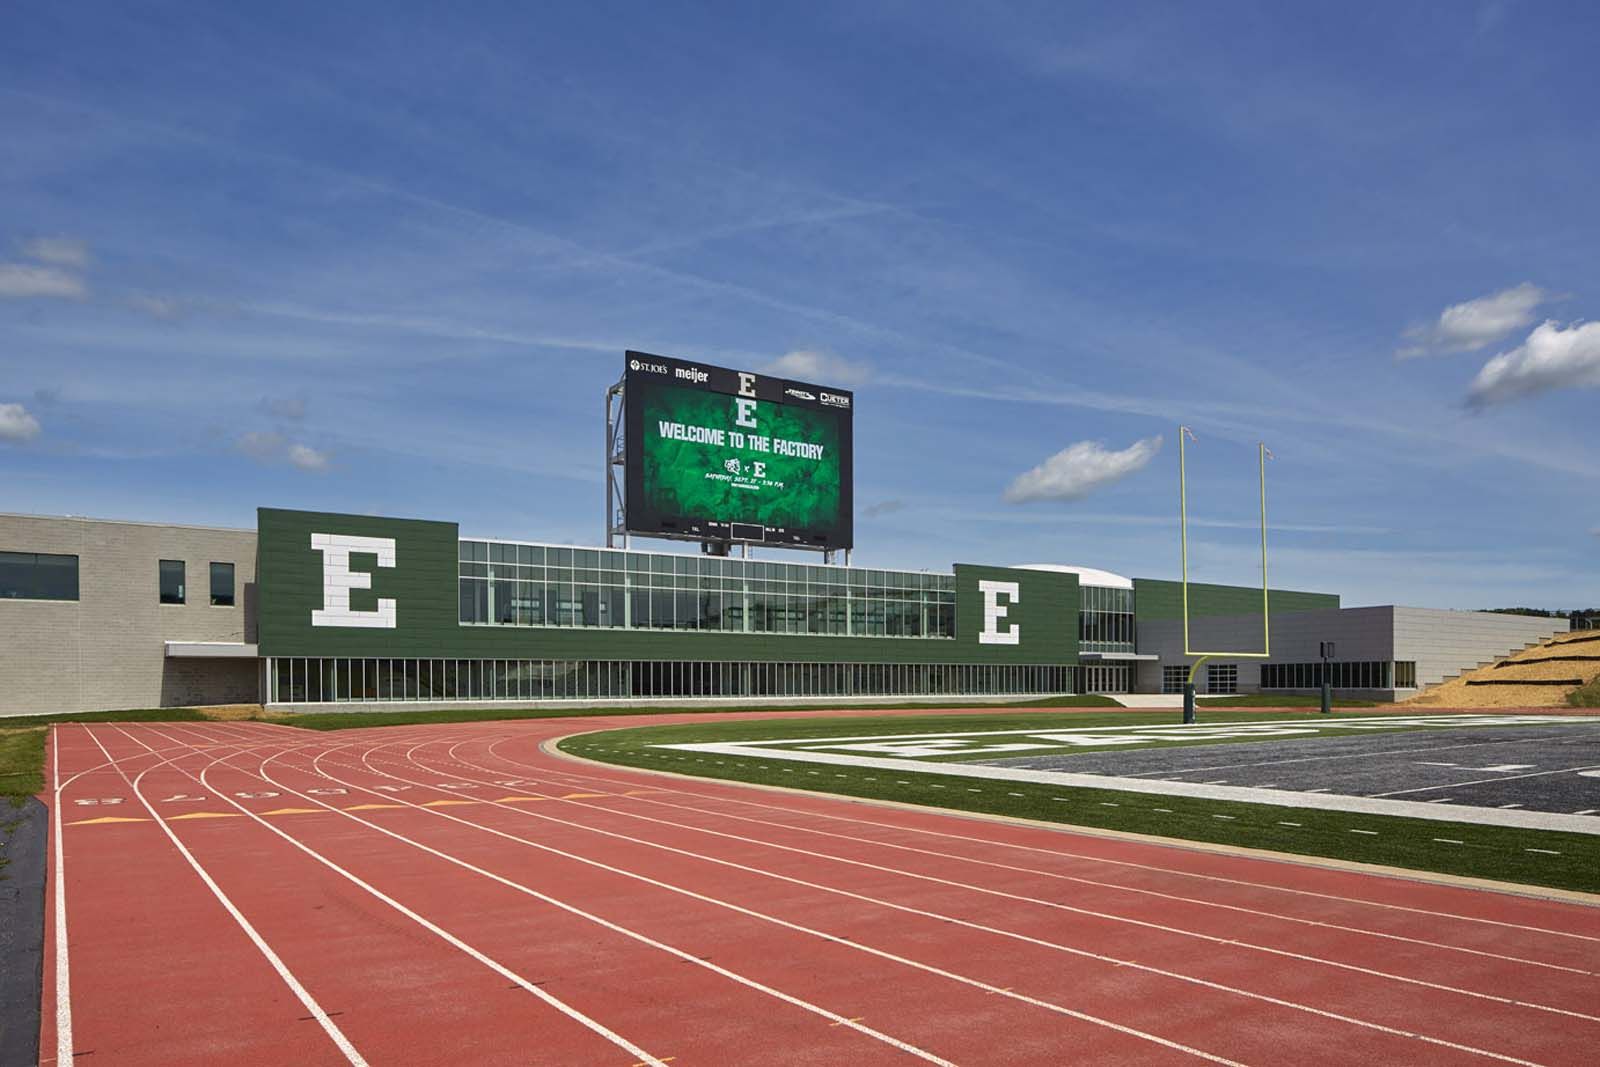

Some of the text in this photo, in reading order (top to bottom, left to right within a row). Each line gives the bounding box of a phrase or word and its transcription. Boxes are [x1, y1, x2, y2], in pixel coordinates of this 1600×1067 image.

[675, 367, 709, 383] meijer
[738, 372, 756, 398] E
[735, 397, 757, 429] E
[658, 421, 824, 461] WELCOME TO THE FACTORY
[753, 461, 766, 478] E
[311, 533, 396, 629] E
[979, 580, 1019, 645] E
[161, 794, 208, 802] 7
